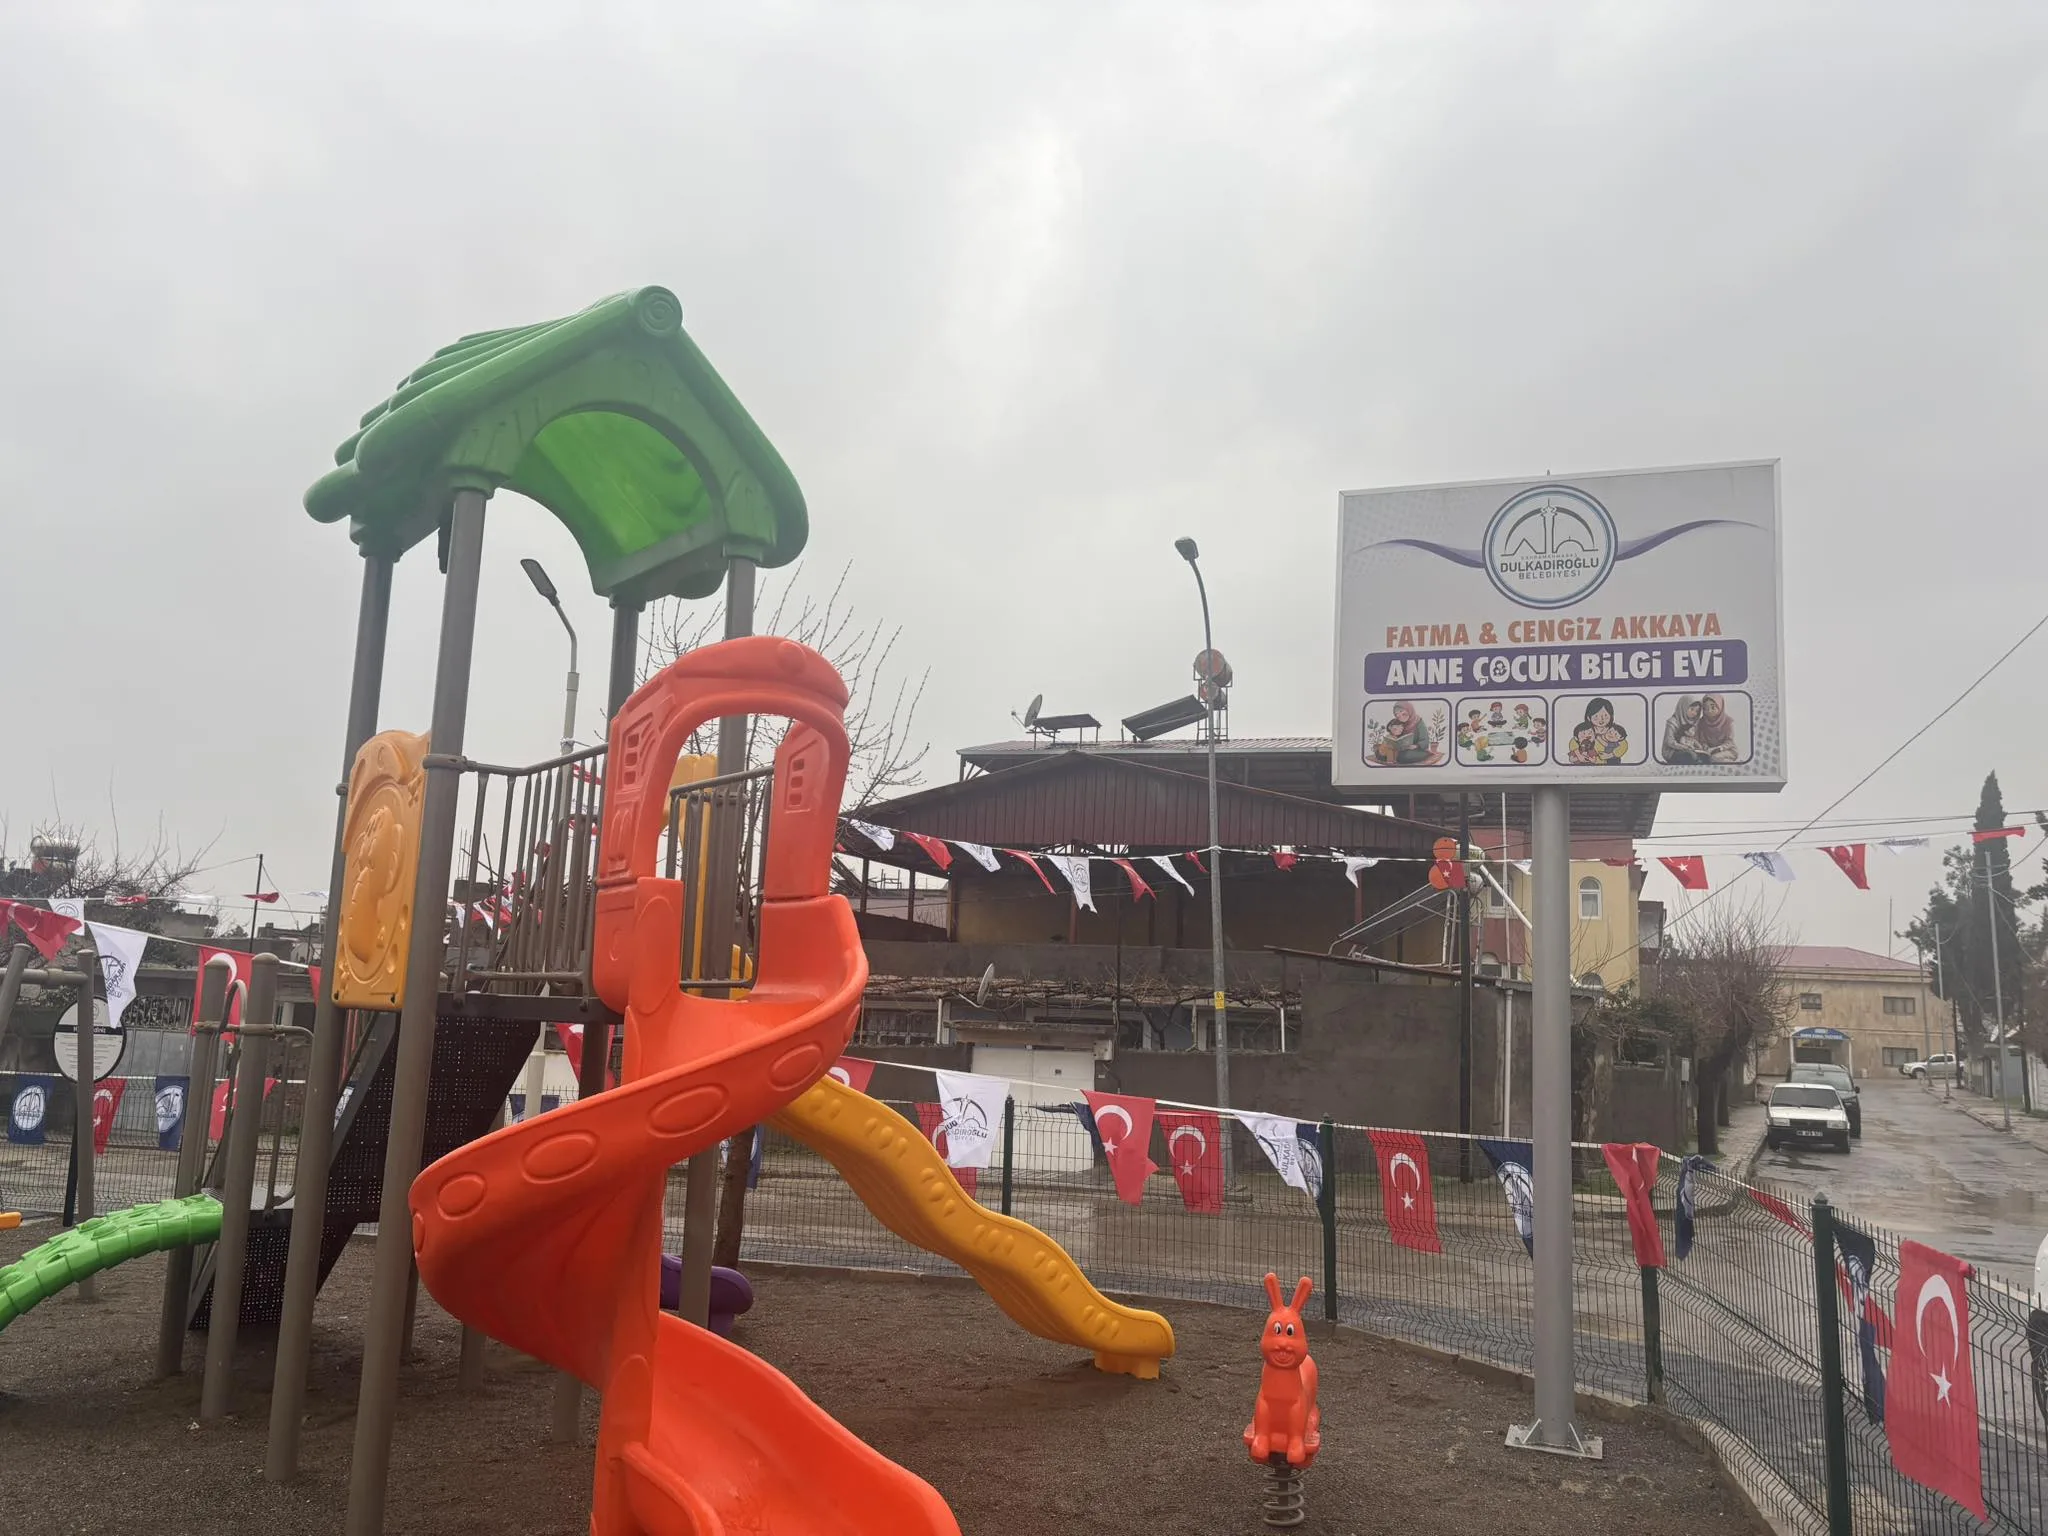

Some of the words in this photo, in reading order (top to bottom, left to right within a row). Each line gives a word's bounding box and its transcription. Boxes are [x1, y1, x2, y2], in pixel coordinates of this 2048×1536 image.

[1386, 623, 1470, 648] FATMA
[1479, 622, 1498, 645] &
[1610, 613, 1722, 640] AKKAYA
[1386, 657, 1463, 686] ANNE
[1472, 654, 1571, 687] ÇOCUK
